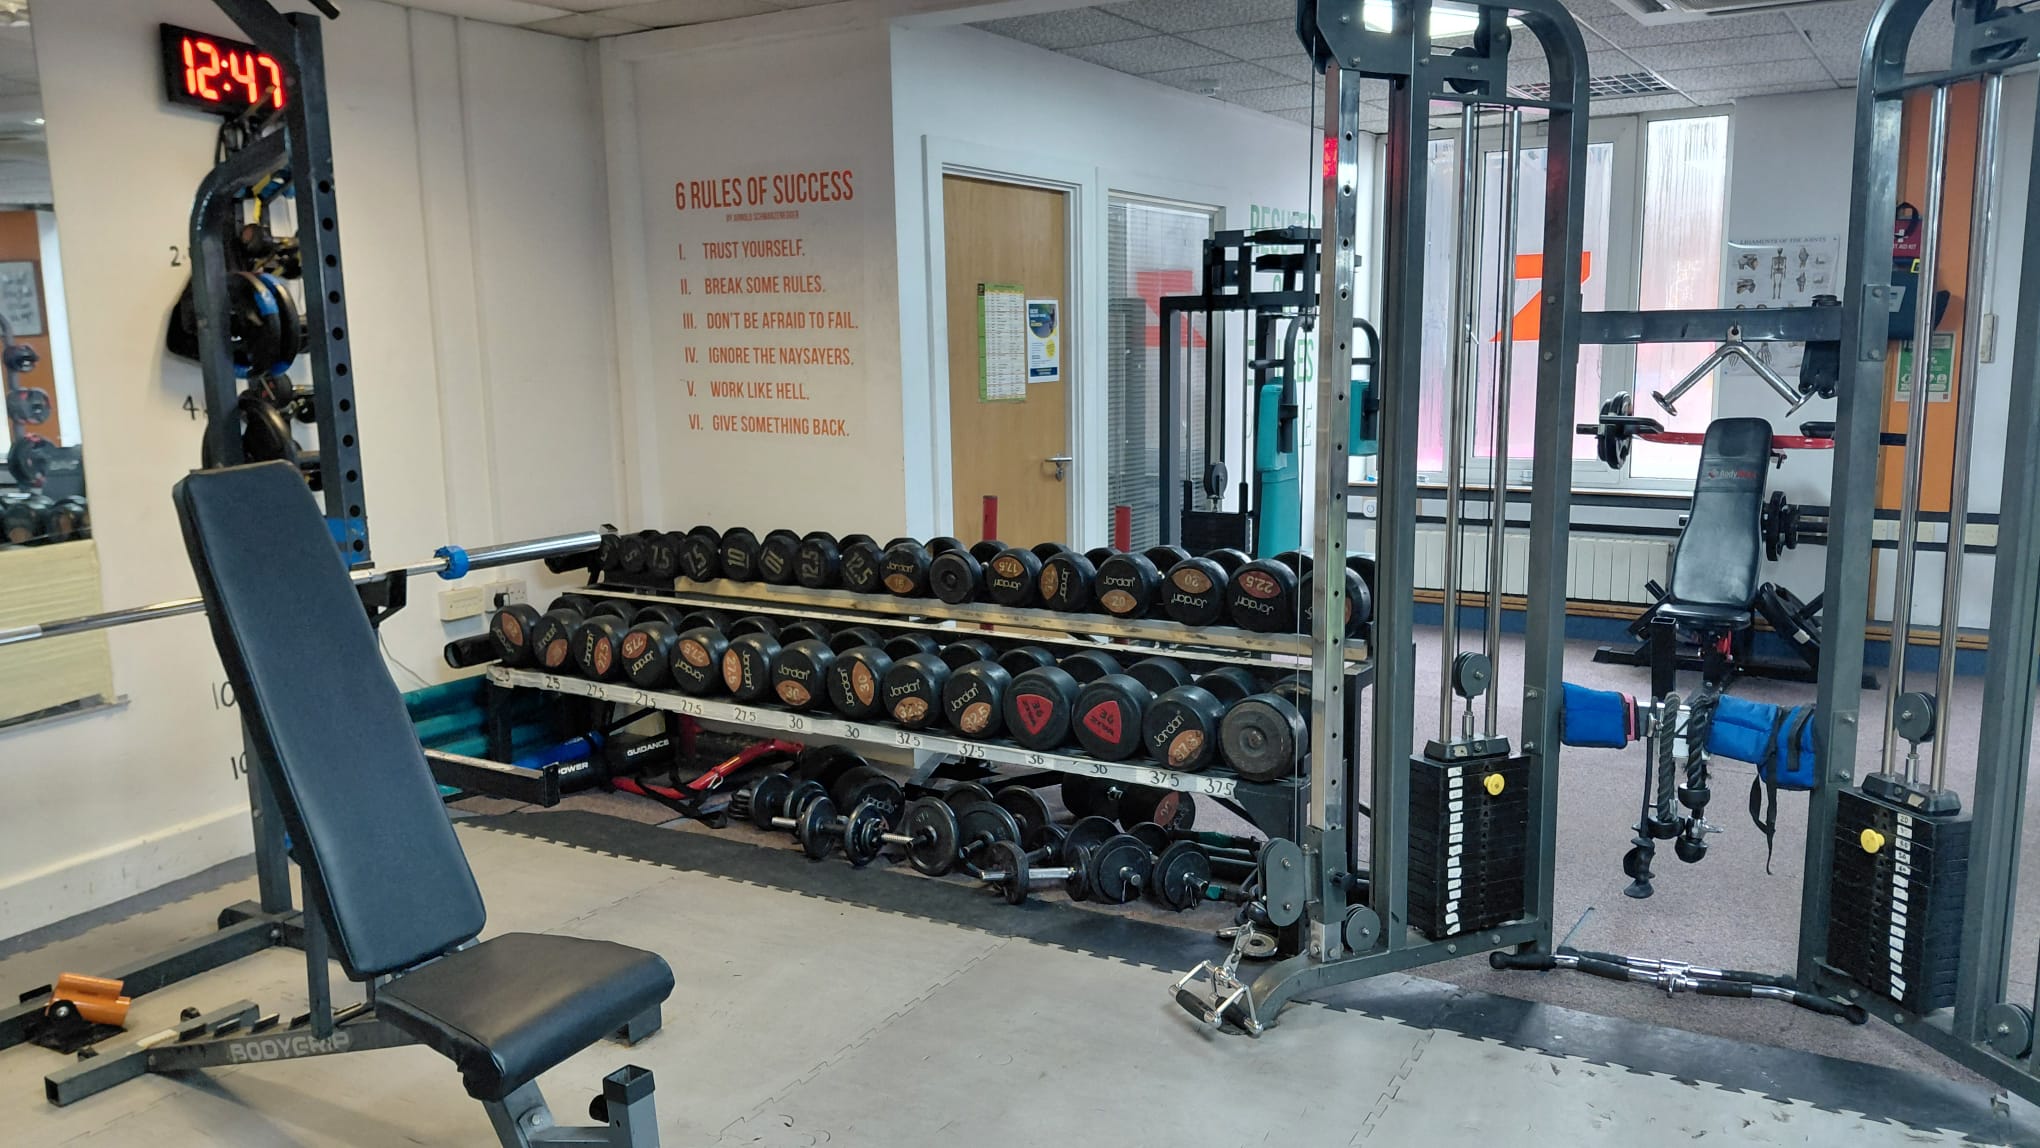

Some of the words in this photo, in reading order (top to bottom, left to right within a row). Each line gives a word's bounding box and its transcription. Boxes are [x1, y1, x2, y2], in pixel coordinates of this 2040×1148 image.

[181, 36, 284, 109] 12:47
[675, 182, 686, 210] 6
[690, 177, 742, 209] RULES
[747, 175, 768, 205] OF
[773, 170, 854, 204] SUCCESS
[703, 241, 739, 259] TRUST
[742, 239, 805, 258] YOURSELF.
[680, 278, 692, 295] II.
[705, 277, 743, 295] BREAK
[746, 276, 780, 294] SOME
[783, 275, 825, 293] RULES.
[683, 313, 697, 329] III.
[707, 312, 741, 329] DON'T
[744, 312, 759, 329] BE
[762, 311, 806, 329] AFRAID
[808, 311, 824, 329] TO
[828, 311, 859, 329] FAIL.
[685, 347, 698, 364] IV.
[709, 347, 750, 364] IGNORE
[752, 347, 776, 364] THE
[779, 347, 854, 366] NAYSAYERS.
[687, 381, 697, 397] V.
[710, 381, 745, 398] WORK
[747, 382, 773, 399] LIKE
[776, 382, 810, 400] HELL.
[688, 413, 703, 431] VI.
[712, 415, 738, 432] GIVE
[741, 415, 809, 435] SOMETHING
[812, 418, 850, 437] BACK.
[886, 561, 915, 573] Jordan
[994, 578, 1022, 591] Jordan
[1059, 568, 1071, 601] Jordan
[1103, 575, 1136, 588] Jordan
[1184, 575, 1199, 587] 20
[1245, 575, 1274, 593] 22.5
[1111, 596, 1126, 606] 20
[1171, 593, 1207, 608] Jordan
[1235, 595, 1274, 615] Jordan
[583, 629, 594, 666] Jordan
[631, 650, 654, 676] Jordan
[675, 658, 705, 682] Jordan
[742, 651, 755, 691] Jordan
[778, 663, 811, 680] Jordan
[786, 687, 799, 699] 30
[838, 667, 855, 706] Jordan
[890, 678, 921, 698] Jordan
[546, 676, 561, 689] 25
[789, 715, 804, 730] 30
[845, 725, 860, 739] 30
[951, 683, 978, 712] Jordan
[1154, 710, 1185, 747] Jordan
[626, 739, 670, 757] GUIDANCE
[558, 761, 589, 775] OWER
